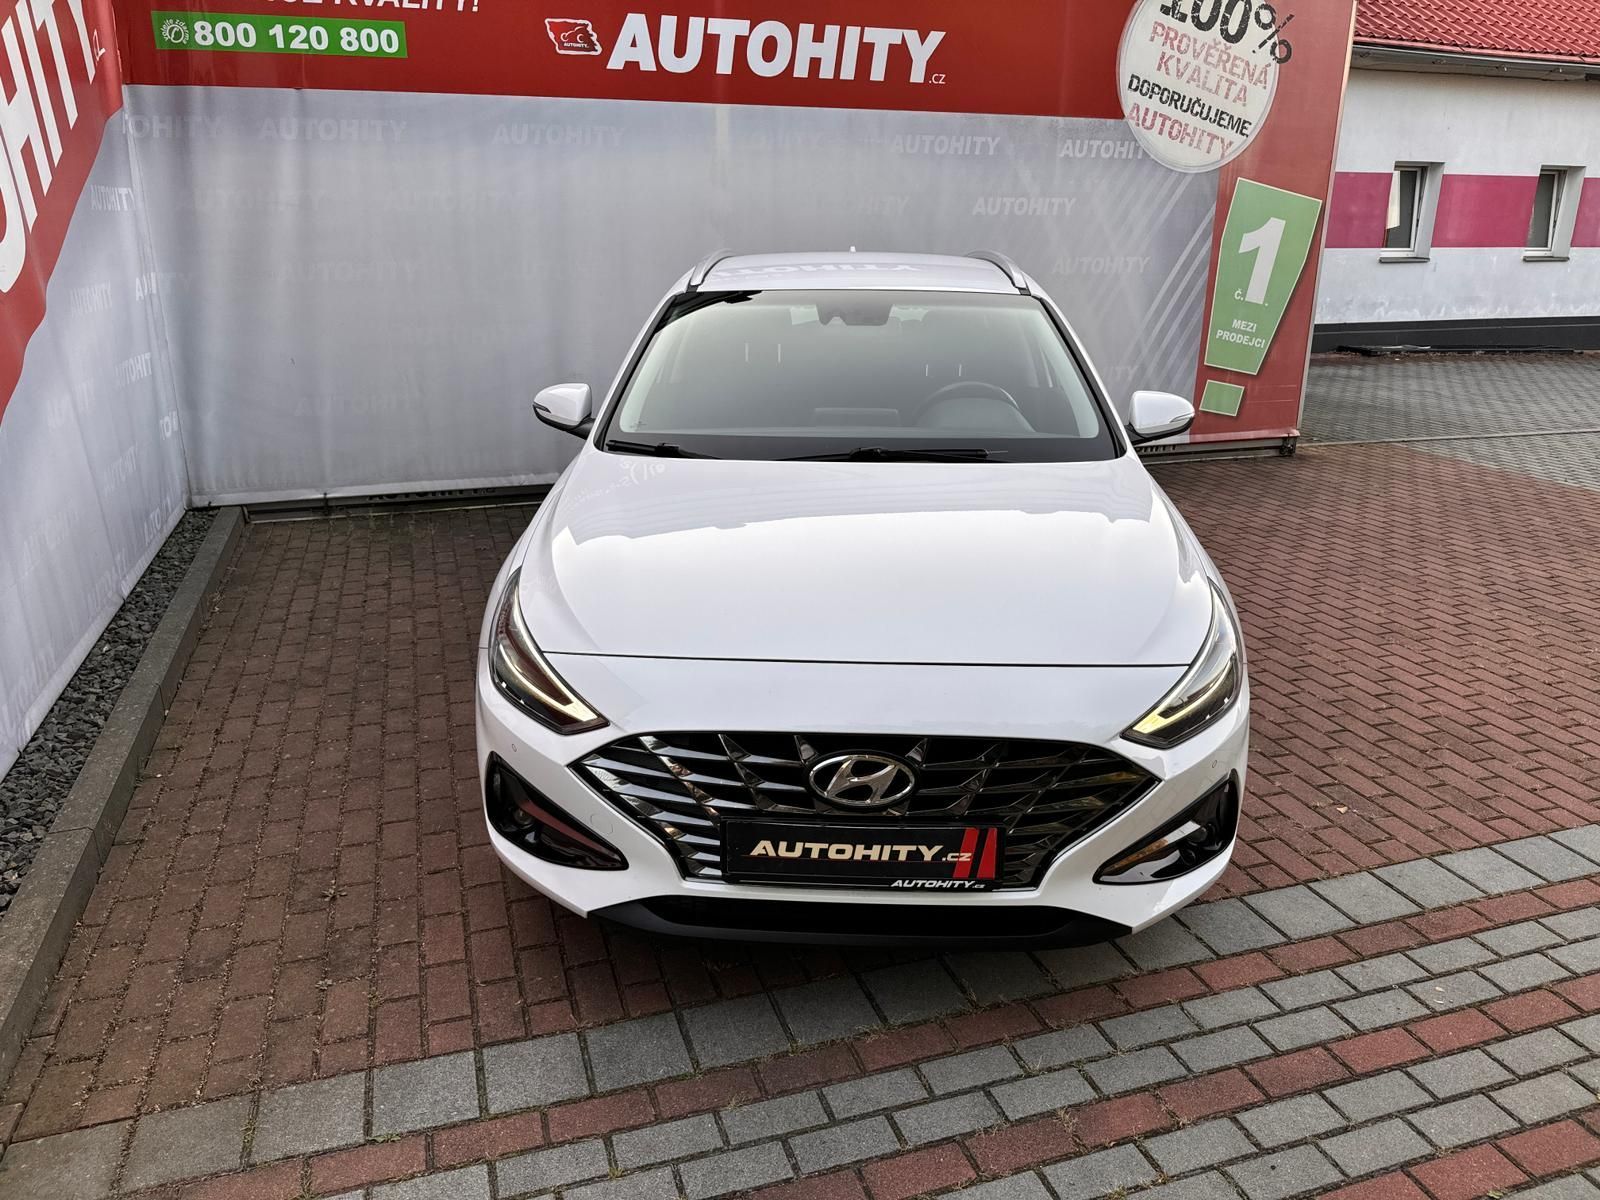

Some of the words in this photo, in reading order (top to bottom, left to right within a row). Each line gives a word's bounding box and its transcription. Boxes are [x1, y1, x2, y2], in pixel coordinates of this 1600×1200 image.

[194, 20, 257, 48] 800
[268, 23, 329, 50] 120
[340, 28, 399, 54] 800
[1149, 21, 1271, 90] PROVĚŘENÁ
[1156, 51, 1247, 107] KVALITA
[1128, 74, 1252, 137] DOPORUČUJEME
[258, 117, 407, 141] AUTOHITY
[491, 123, 625, 146] AUTOHITY
[1126, 102, 1234, 159] AUTOHITY
[893, 134, 1000, 156] AUTOHITY
[972, 197, 1076, 216] AUTOHITY
[1232, 319, 1256, 333] MEZI
[1216, 329, 1265, 348] PRODEJCI
[750, 840, 972, 862] AUTOHITY.cz
